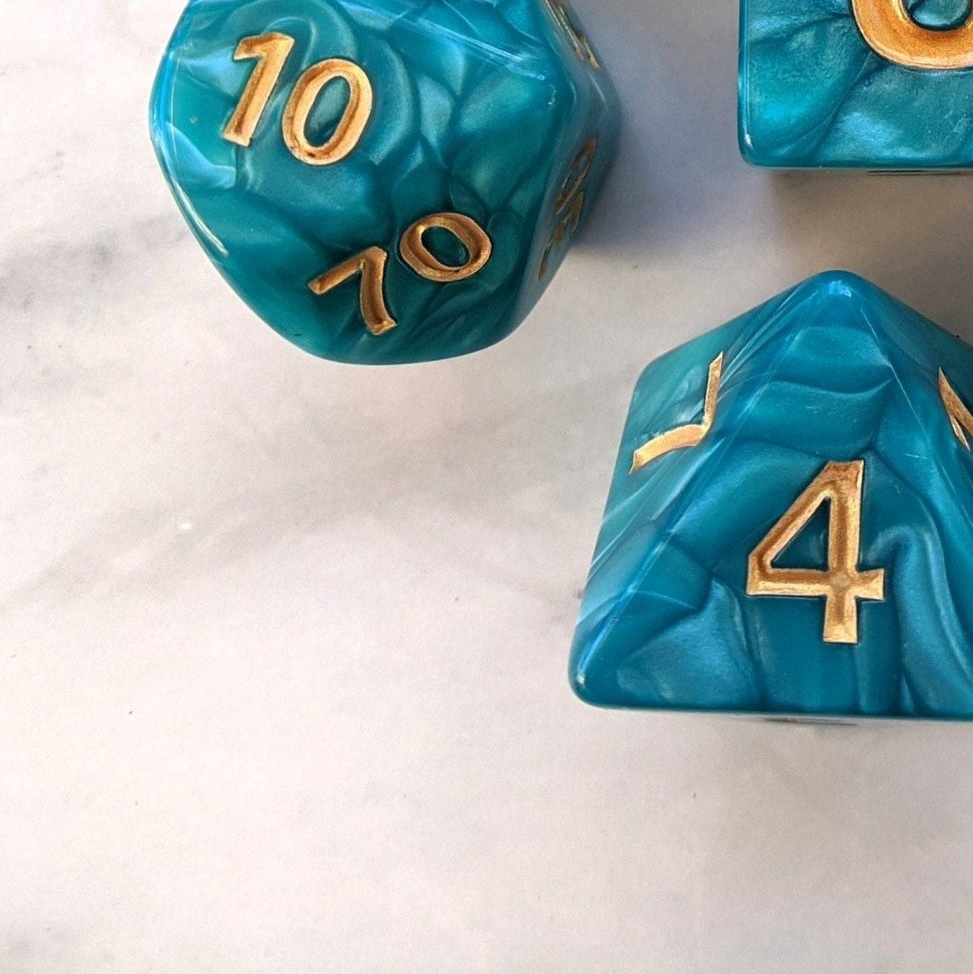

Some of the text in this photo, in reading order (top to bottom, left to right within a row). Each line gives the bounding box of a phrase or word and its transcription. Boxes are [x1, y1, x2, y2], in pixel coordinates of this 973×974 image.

[224, 32, 373, 165] 10
[310, 212, 493, 335] 70
[747, 460, 886, 643] 4
